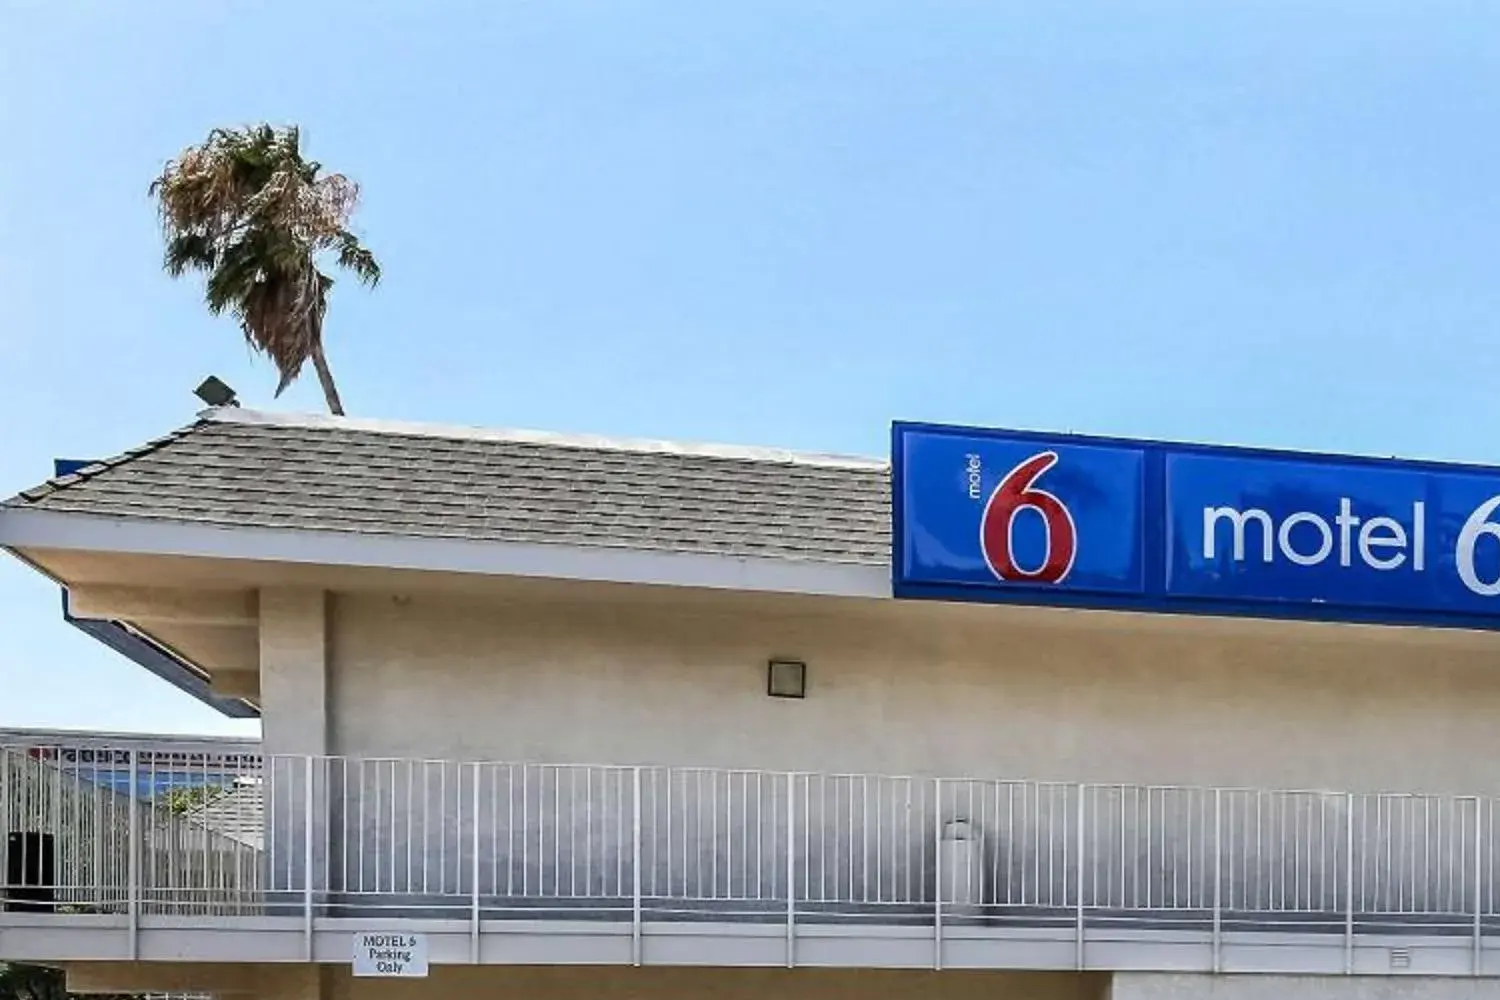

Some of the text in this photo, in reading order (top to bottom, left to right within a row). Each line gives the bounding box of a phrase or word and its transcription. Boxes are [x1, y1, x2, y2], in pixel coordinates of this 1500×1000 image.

[966, 450, 1077, 585] motel 6
[1203, 497, 1425, 571] motel
[363, 935, 417, 947] MOTEL 6
[369, 948, 411, 962] Parking
[376, 961, 403, 974] Only
